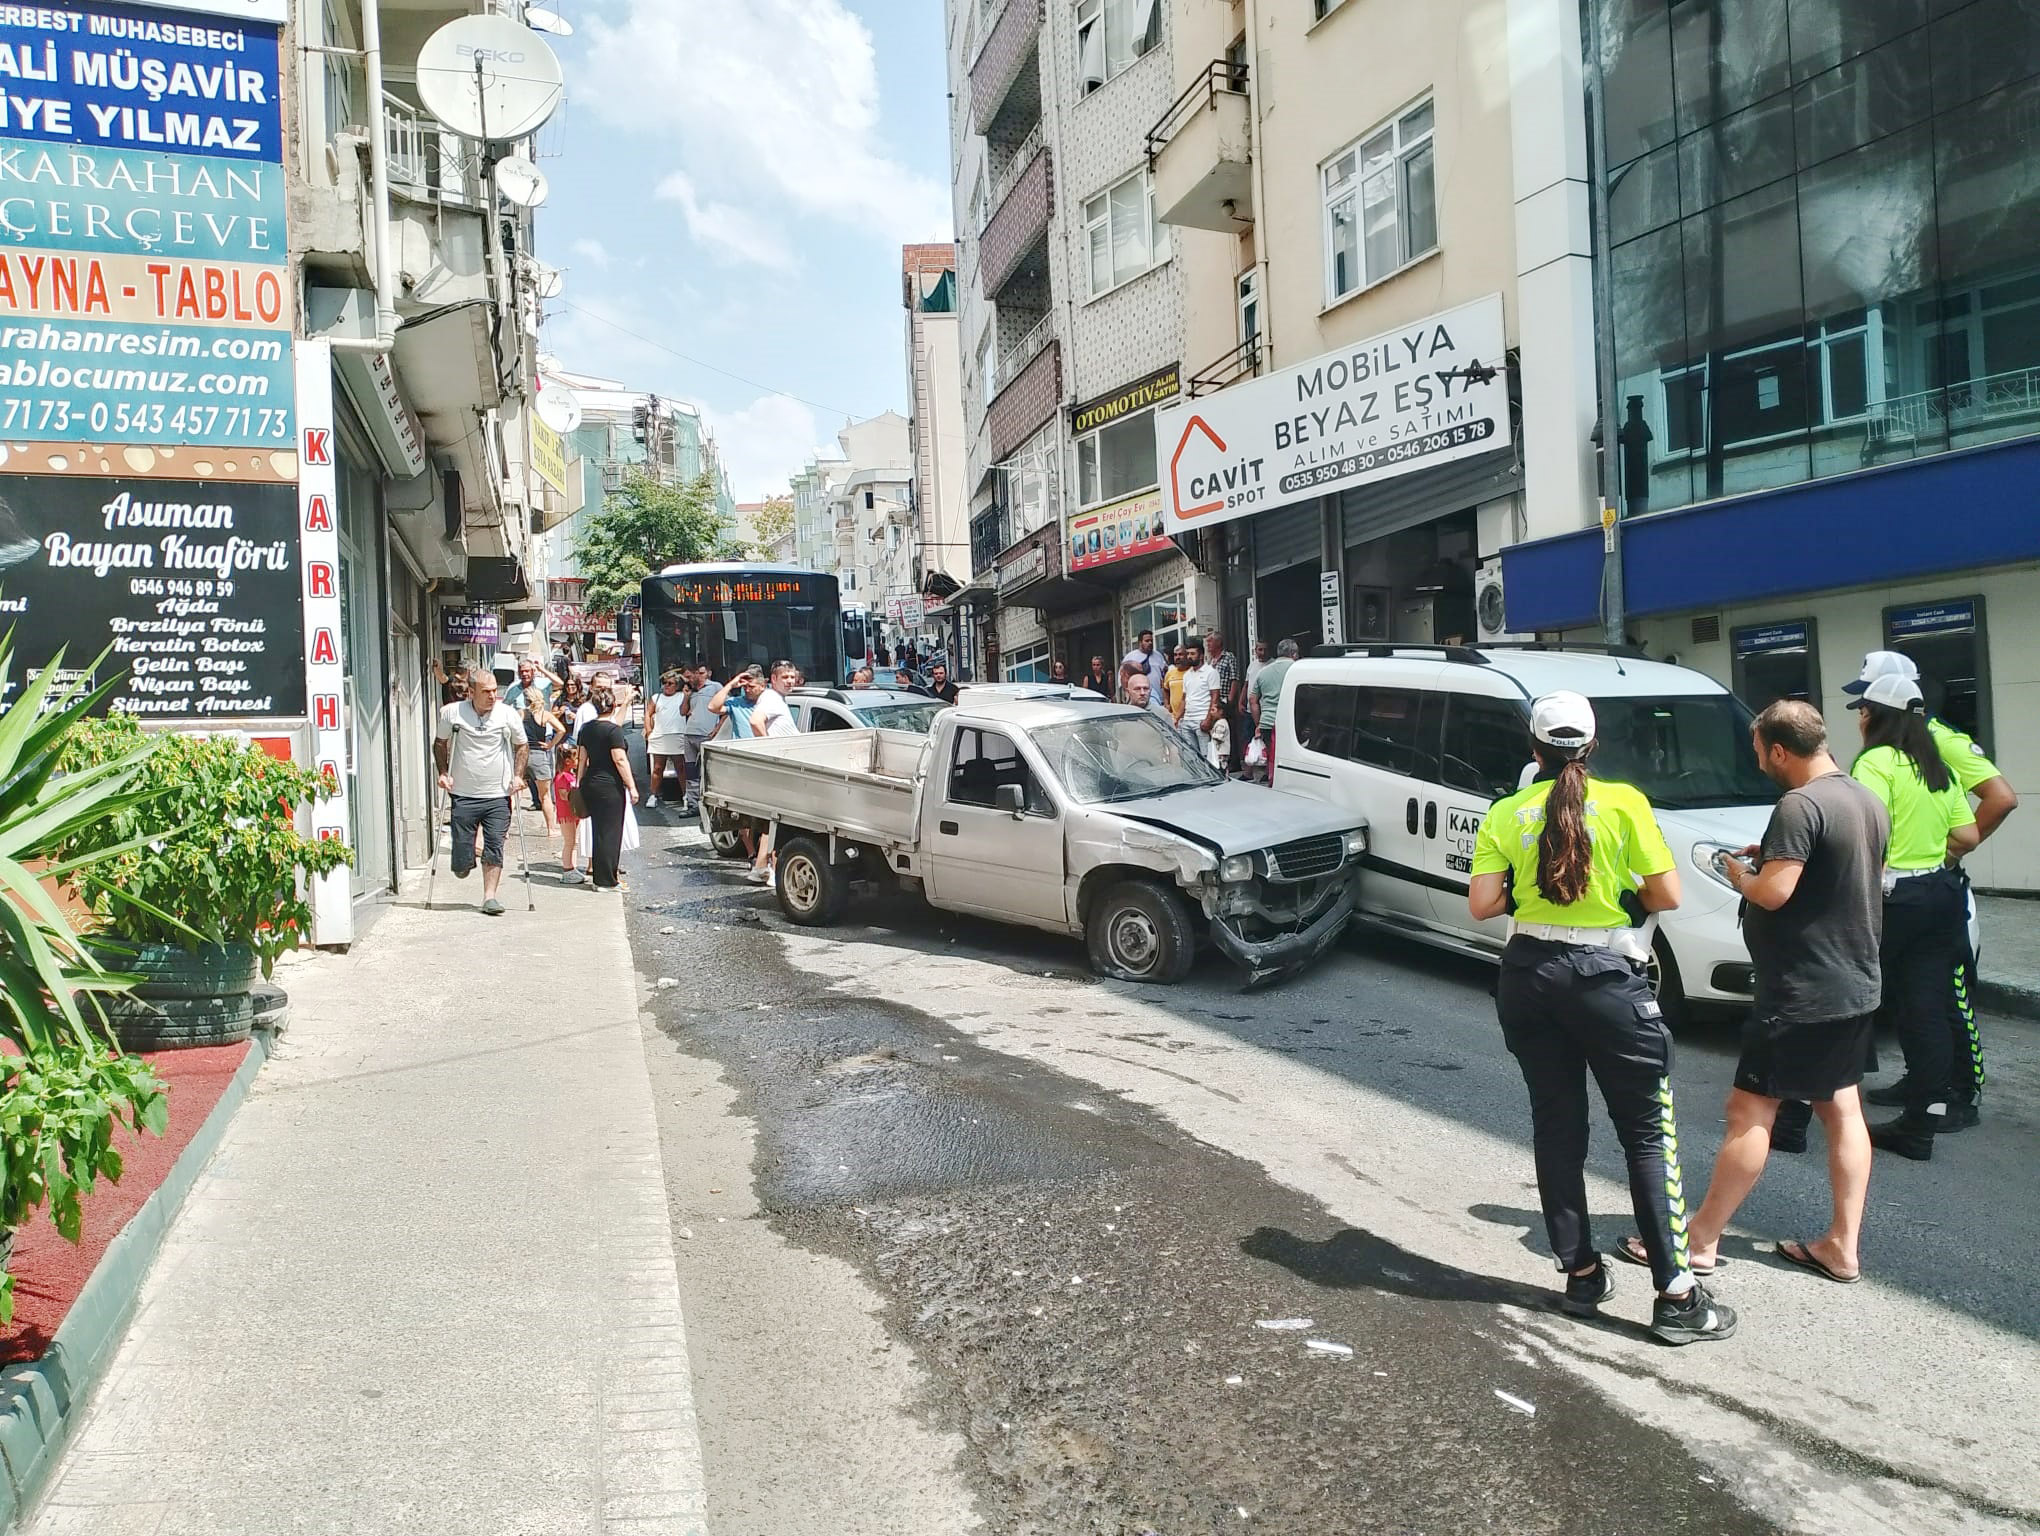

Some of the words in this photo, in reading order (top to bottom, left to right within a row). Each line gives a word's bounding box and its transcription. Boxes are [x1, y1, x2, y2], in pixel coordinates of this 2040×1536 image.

[89, 15, 244, 51] MUHASEBECİ
[0, 40, 57, 82] ALİ
[72, 49, 267, 104] MÜŞAVİR
[455, 44, 525, 64] BEKO
[86, 103, 261, 152] YILMAZ
[0, 147, 262, 201] KARAHAN
[0, 198, 270, 250] ÇERÇEVE
[0, 254, 111, 314] AYNA
[147, 263, 282, 323] TABLO
[0, 324, 282, 361] rahanresim.com
[1076, 384, 1155, 431] OTOMOTİV
[1156, 372, 1176, 387] ALIM
[1154, 382, 1179, 400] SATIM
[1275, 392, 1380, 450] BEYAZ
[1395, 358, 1492, 415] EŞYA
[1294, 441, 1344, 469] ALIM
[1357, 434, 1378, 449] ve
[1390, 402, 1474, 441] SATIMI
[1285, 472, 1314, 490] 0535
[1316, 464, 1339, 482] 950
[1341, 459, 1356, 475] 48
[1359, 454, 1375, 470] 30
[1387, 442, 1420, 462] 0546
[1424, 433, 1450, 452] 206
[1452, 428, 1466, 444] 15
[1469, 421, 1486, 439] 78
[1190, 457, 1265, 500] CAVİT
[1227, 486, 1266, 508] SPOT
[101, 492, 233, 530] Asuman
[45, 532, 153, 577] Bayan
[160, 534, 289, 578] Kuaförü
[130, 578, 164, 595] 0546
[167, 580, 193, 596] 946
[196, 581, 213, 596] 89
[216, 582, 234, 597] 59
[156, 598, 219, 616] Ağda
[447, 614, 498, 628] UĞUR
[109, 617, 206, 636] Brezilya
[210, 618, 266, 633] Fönü
[114, 637, 196, 653] Keratin
[201, 637, 265, 652] Botox
[303, 428, 347, 842] KARAHA
[132, 657, 190, 675] Gelin
[195, 657, 247, 675] Başı
[129, 677, 194, 695] Nişan
[200, 676, 251, 695] Başı
[110, 697, 189, 713] Sünnet
[195, 696, 272, 713] Annesi
